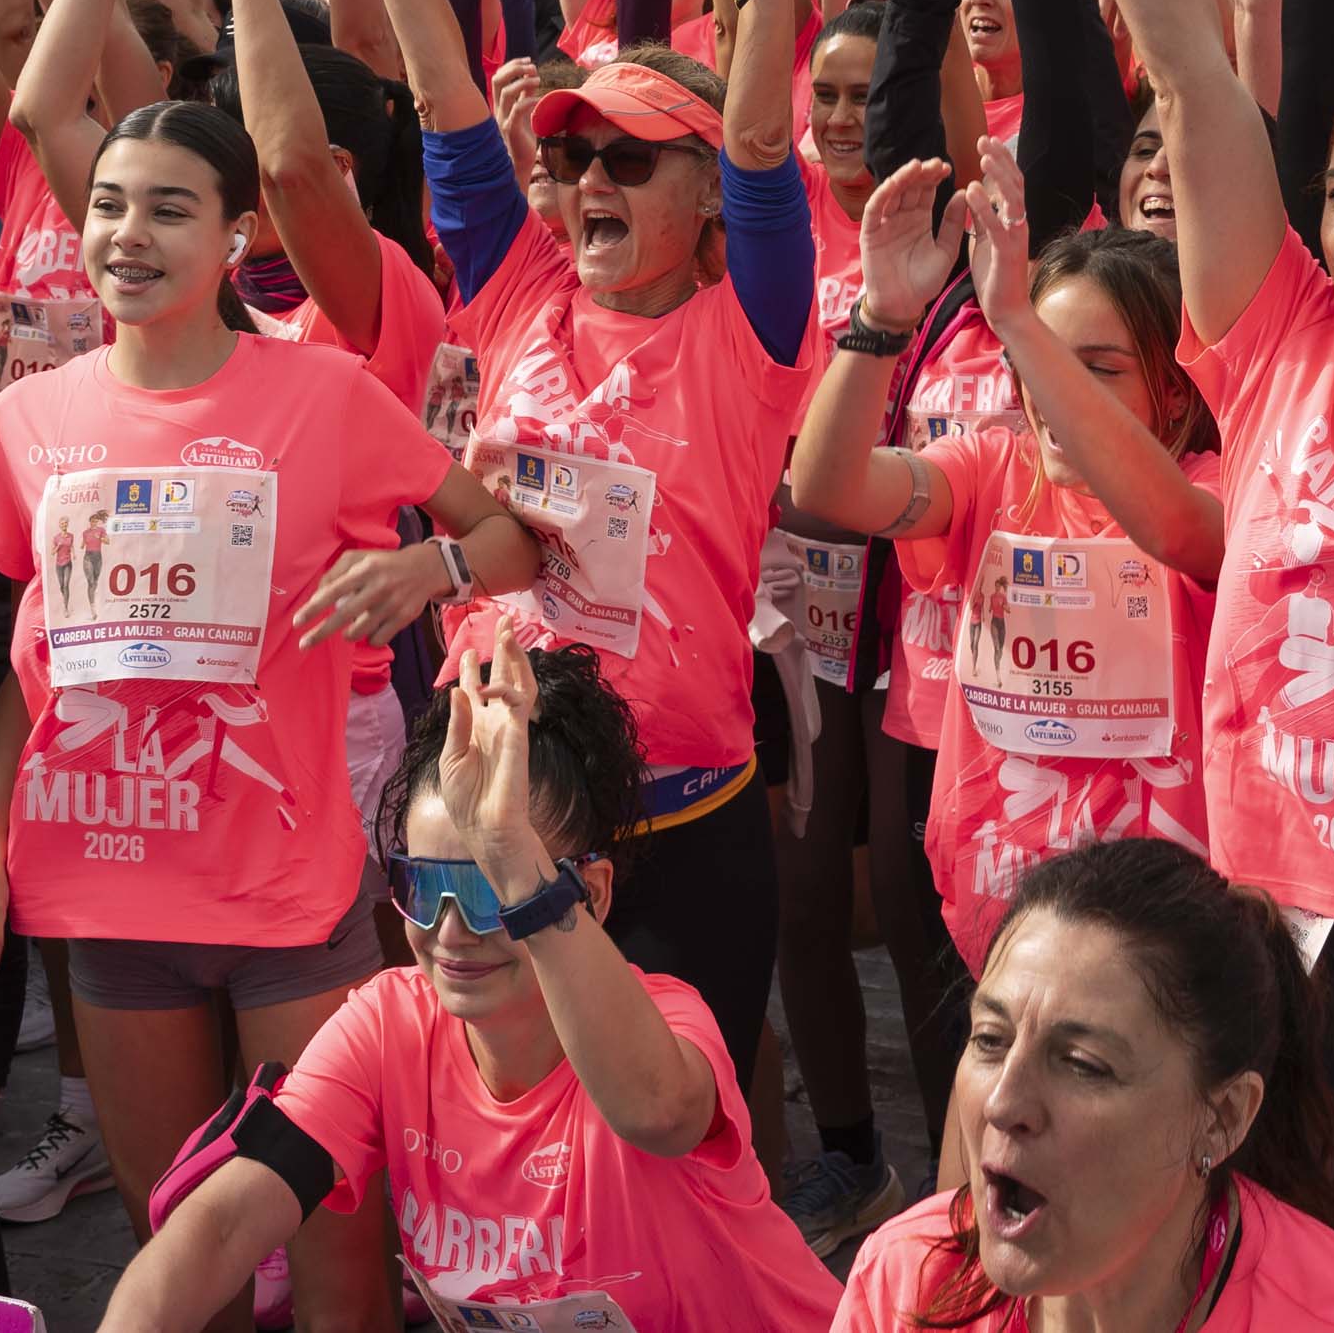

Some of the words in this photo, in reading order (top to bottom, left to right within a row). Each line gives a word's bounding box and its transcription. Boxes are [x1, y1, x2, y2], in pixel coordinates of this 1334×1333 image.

[28, 443, 107, 465] OYSHO
[186, 447, 259, 468] ASTURIANA
[60, 490, 100, 505] SUMA
[546, 554, 571, 580] 2769
[109, 562, 196, 598] 016
[129, 604, 171, 619] 2572
[584, 604, 629, 622] CANARIA
[53, 629, 93, 645] CARRERA
[94, 627, 107, 640] DE
[108, 626, 122, 639] LA
[124, 625, 163, 638] MUJER
[173, 627, 205, 640] GRAN
[210, 628, 253, 643] CANARIA
[66, 658, 97, 672] OYSHO
[122, 652, 167, 665] ASTURIANA
[1012, 636, 1096, 674] 016
[921, 656, 955, 679] 202
[1032, 679, 1073, 697] 3155
[965, 687, 998, 707] CARRERA
[1000, 696, 1011, 709] DE
[1013, 698, 1027, 711] LA
[1029, 700, 1067, 714] MUJER
[1077, 703, 1108, 716] GRAN
[1111, 703, 1160, 716] CANARIA
[113, 705, 165, 776] LA
[1027, 727, 1073, 741] ASTURIANA
[1112, 733, 1150, 743] Santander
[24, 769, 200, 832] MUJER
[84, 831, 145, 863] 2026
